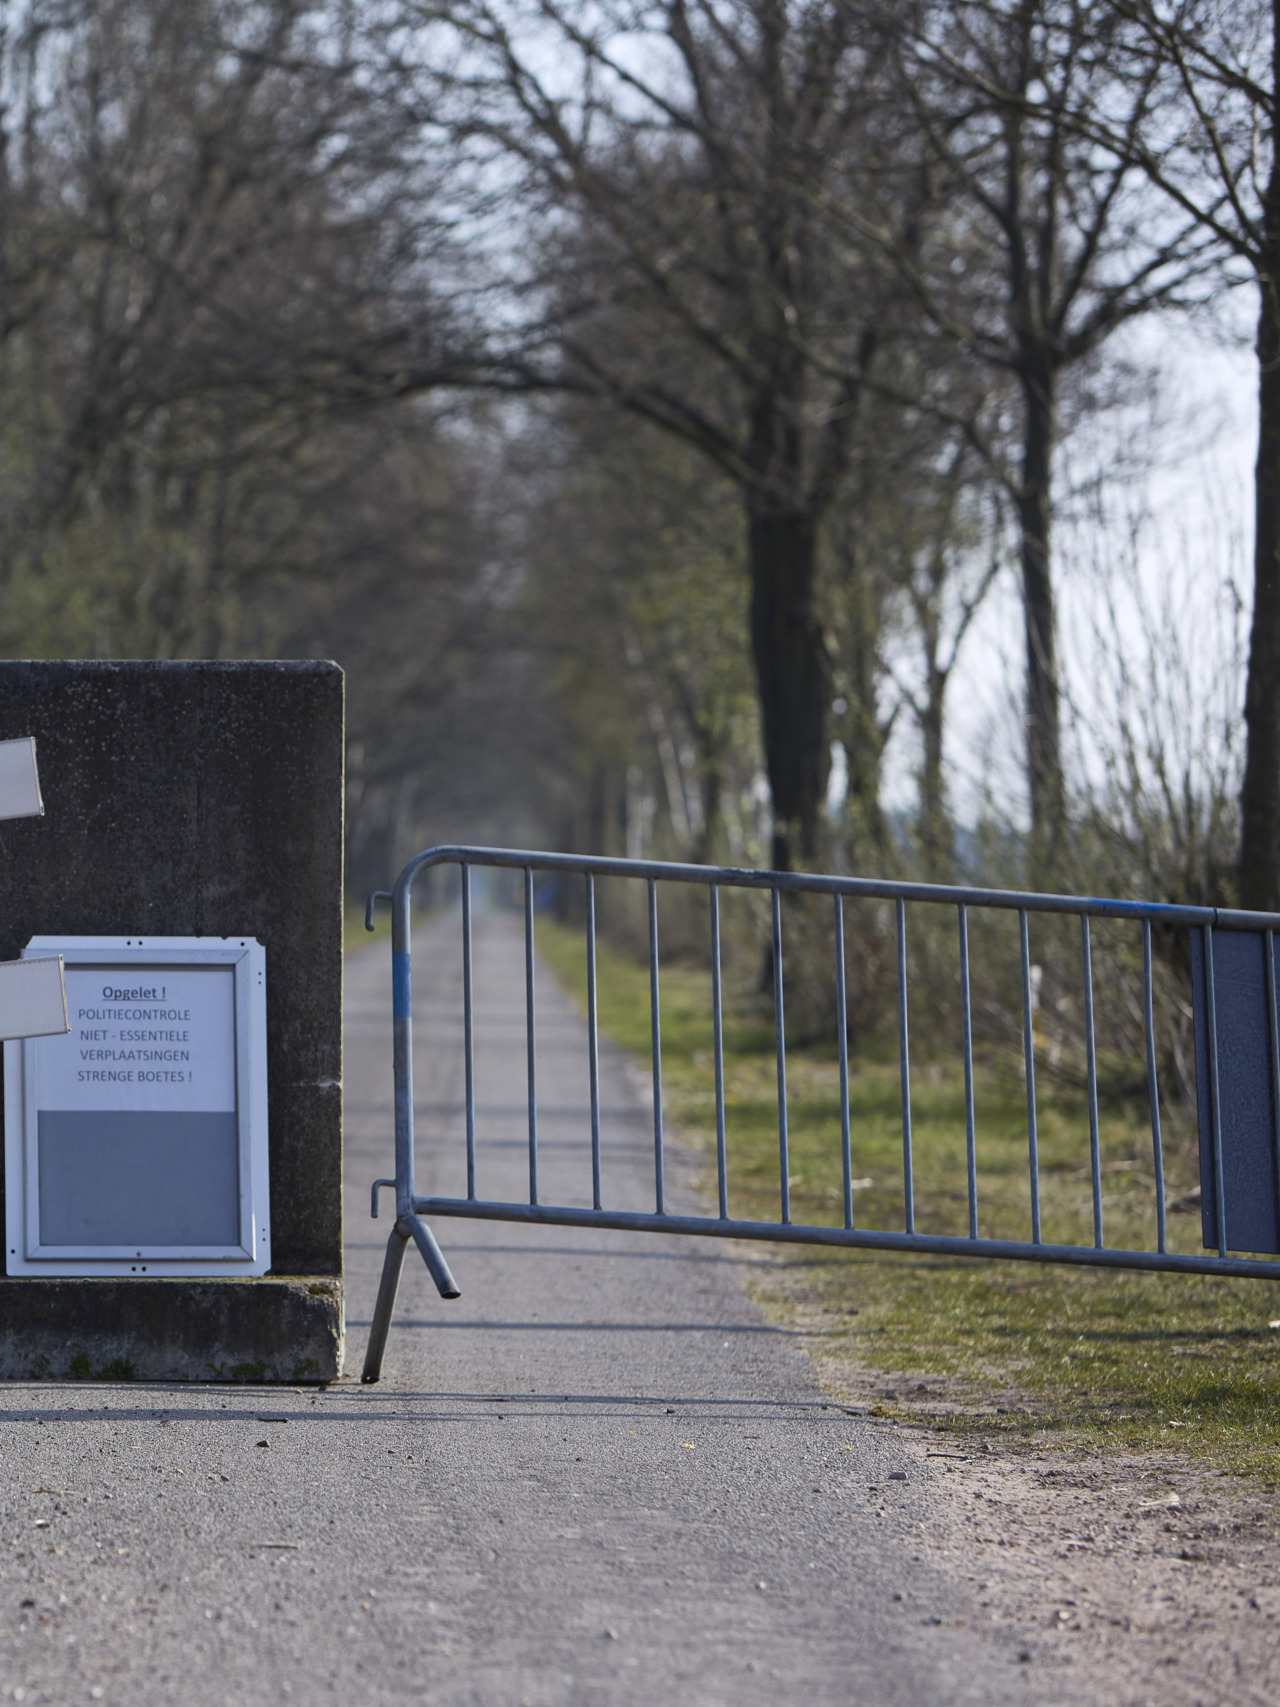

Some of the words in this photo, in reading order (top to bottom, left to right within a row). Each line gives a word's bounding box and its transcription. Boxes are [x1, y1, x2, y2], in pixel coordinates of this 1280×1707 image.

[102, 986, 157, 1001] Opgelet
[161, 986, 166, 1000] !
[78, 1008, 191, 1021] POLITIECONTROLE
[80, 1029, 108, 1041] NIET
[119, 1030, 189, 1042] ESSENTIELE
[79, 1049, 190, 1062] VERPLAATSINGEN
[77, 1070, 134, 1082] STRENGE
[137, 1070, 185, 1083] BOETES
